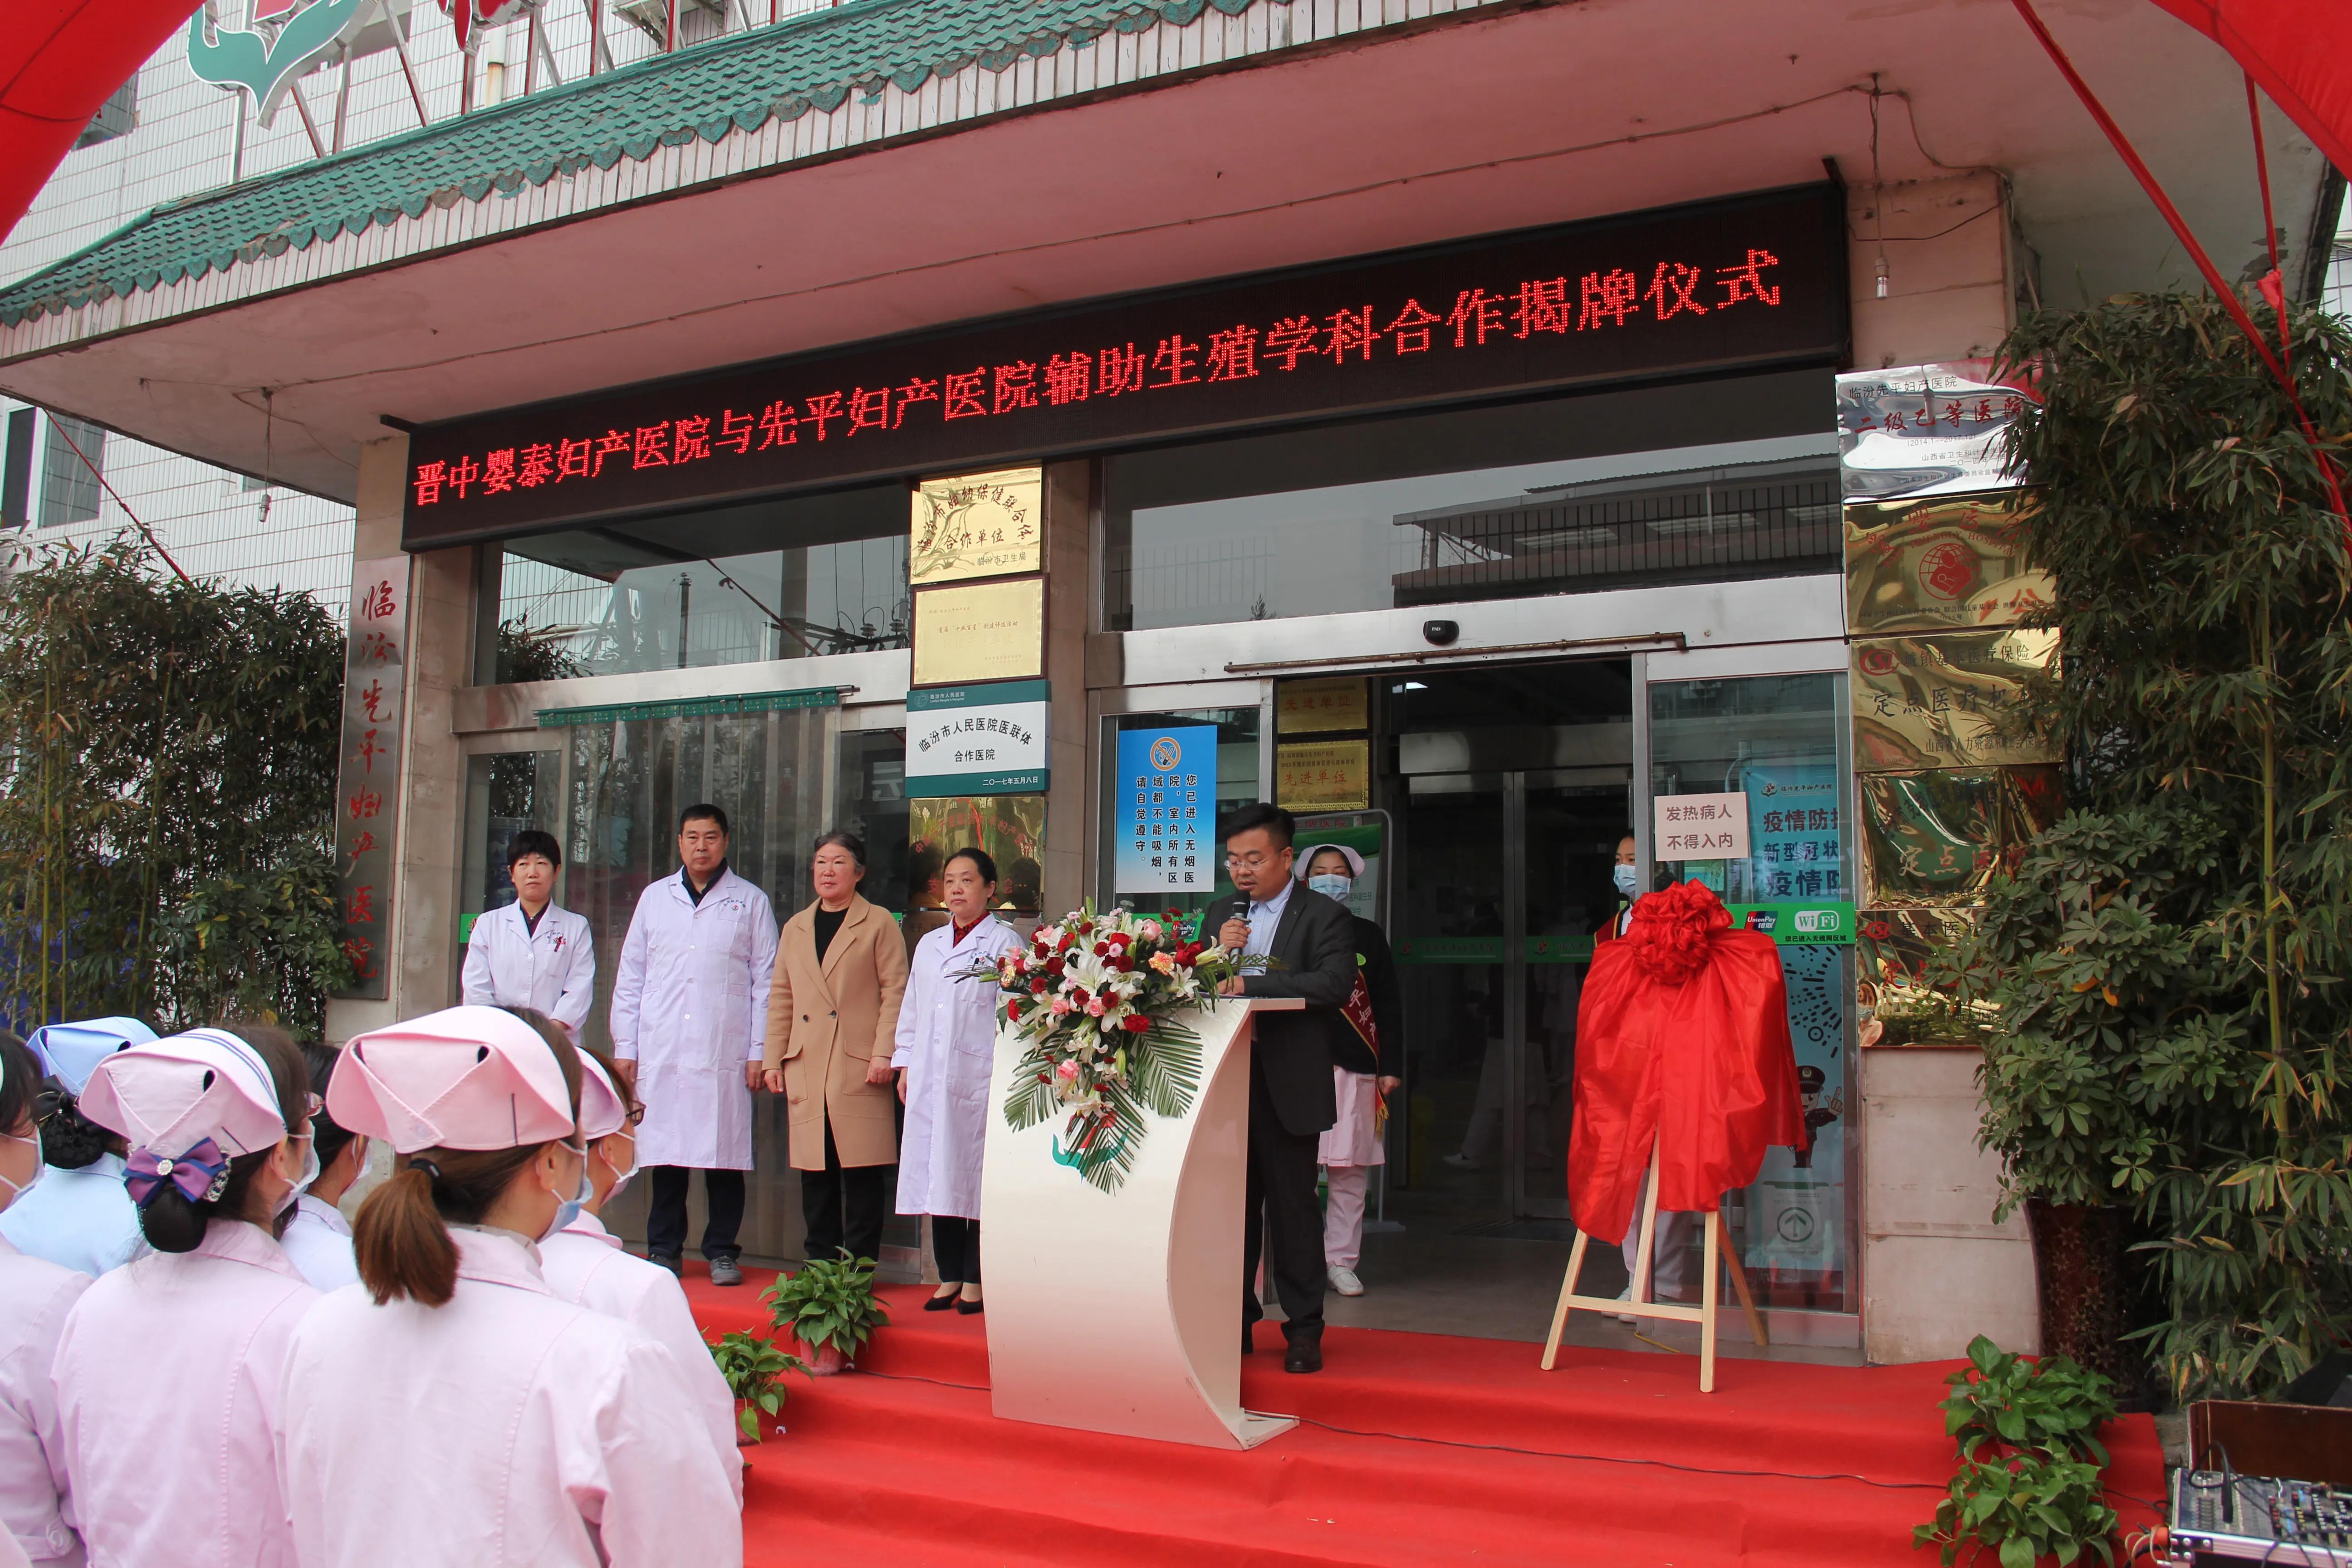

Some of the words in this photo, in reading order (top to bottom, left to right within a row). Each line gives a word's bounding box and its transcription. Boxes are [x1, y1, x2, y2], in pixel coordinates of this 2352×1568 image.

[414, 249, 1780, 505] 晋中婴泰妇产医院与先平妇产医院辅助生殖学科合作揭牌仪式
[1849, 376, 1957, 399] 临汾先平妇产医院
[1855, 396, 2025, 432] 二级乙等医院
[945, 528, 1004, 550] 合作单位
[977, 552, 1026, 566] 临汾市卫生局
[919, 718, 1033, 753] 临汾市人民医院医联体
[954, 748, 996, 763] 合作医院
[345, 579, 397, 980] 临汾先平妇产医院
[1284, 769, 1347, 786] 先进单位
[1666, 804, 1733, 822] 发热病人
[1185, 774, 1197, 883] 您已进入无烟医
[1667, 832, 1733, 851] 不得入内
[1747, 916, 1776, 925] UnionPay
